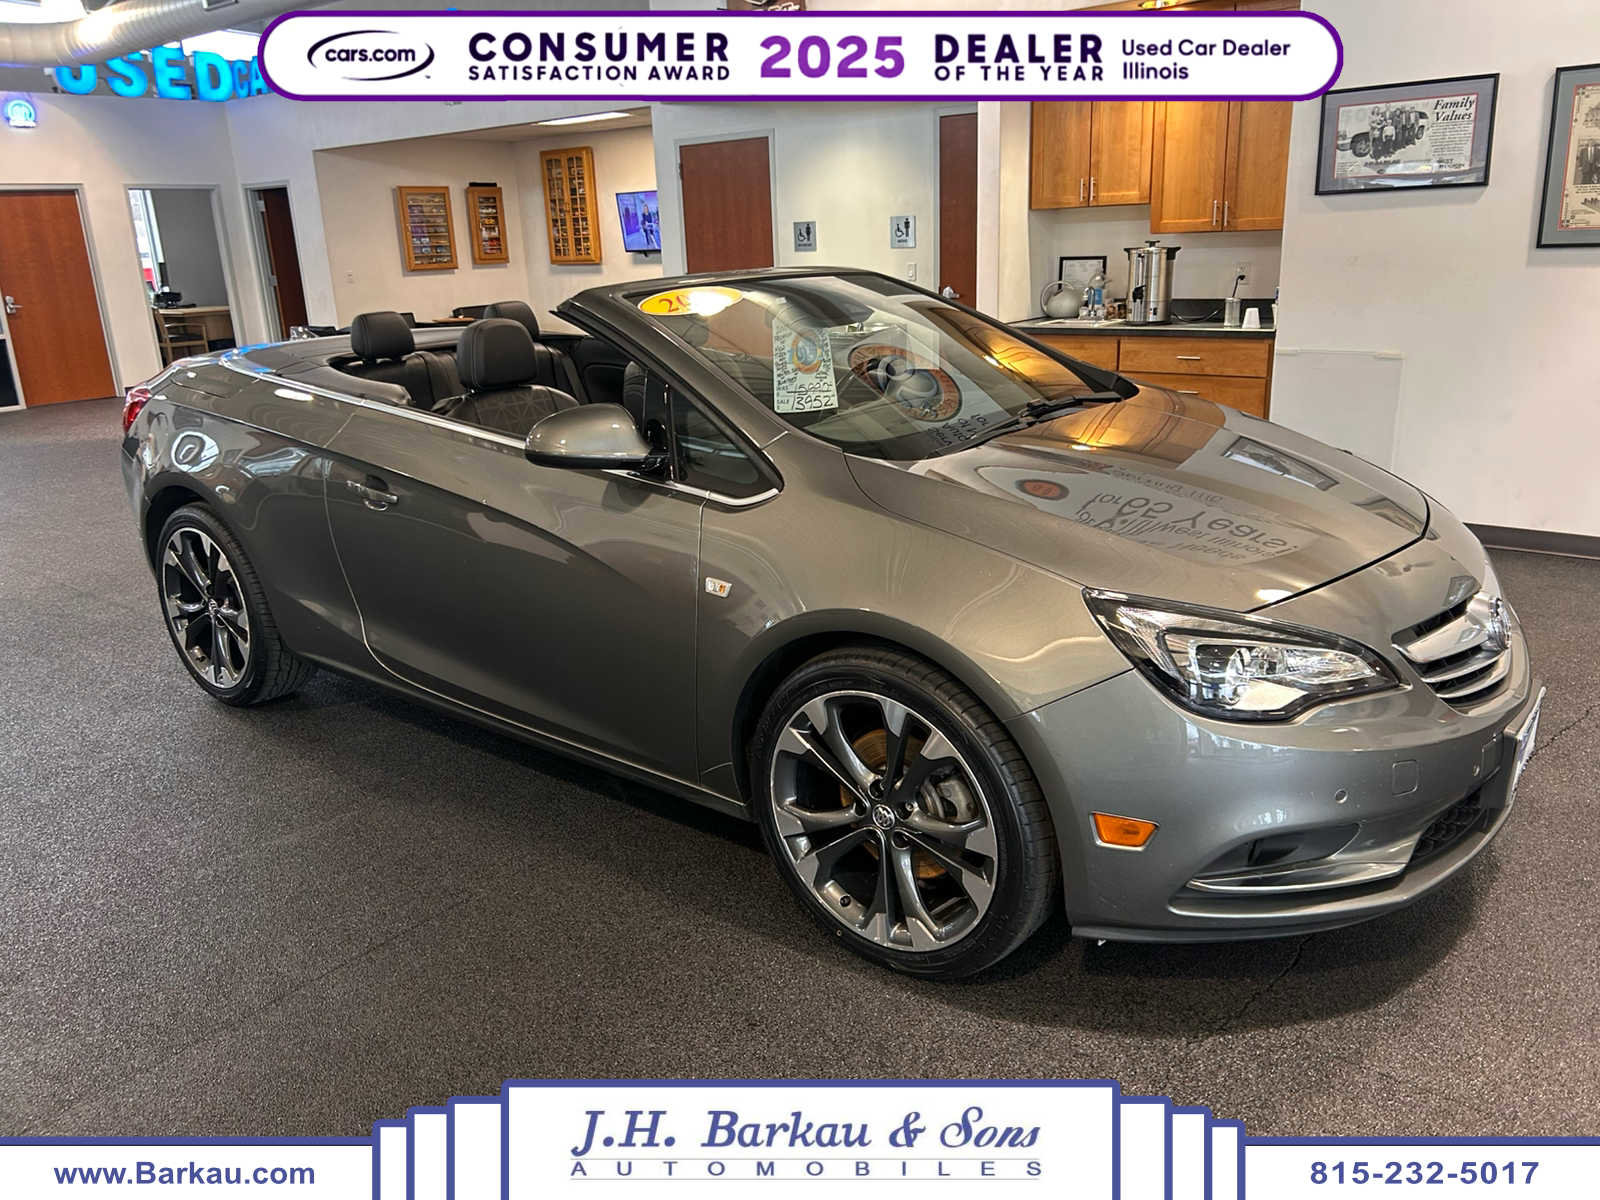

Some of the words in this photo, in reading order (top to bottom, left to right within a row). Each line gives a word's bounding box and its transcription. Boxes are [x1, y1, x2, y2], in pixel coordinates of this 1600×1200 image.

[55, 46, 233, 102] USED
[1433, 97, 1476, 112] Family
[1435, 110, 1473, 122] Values
